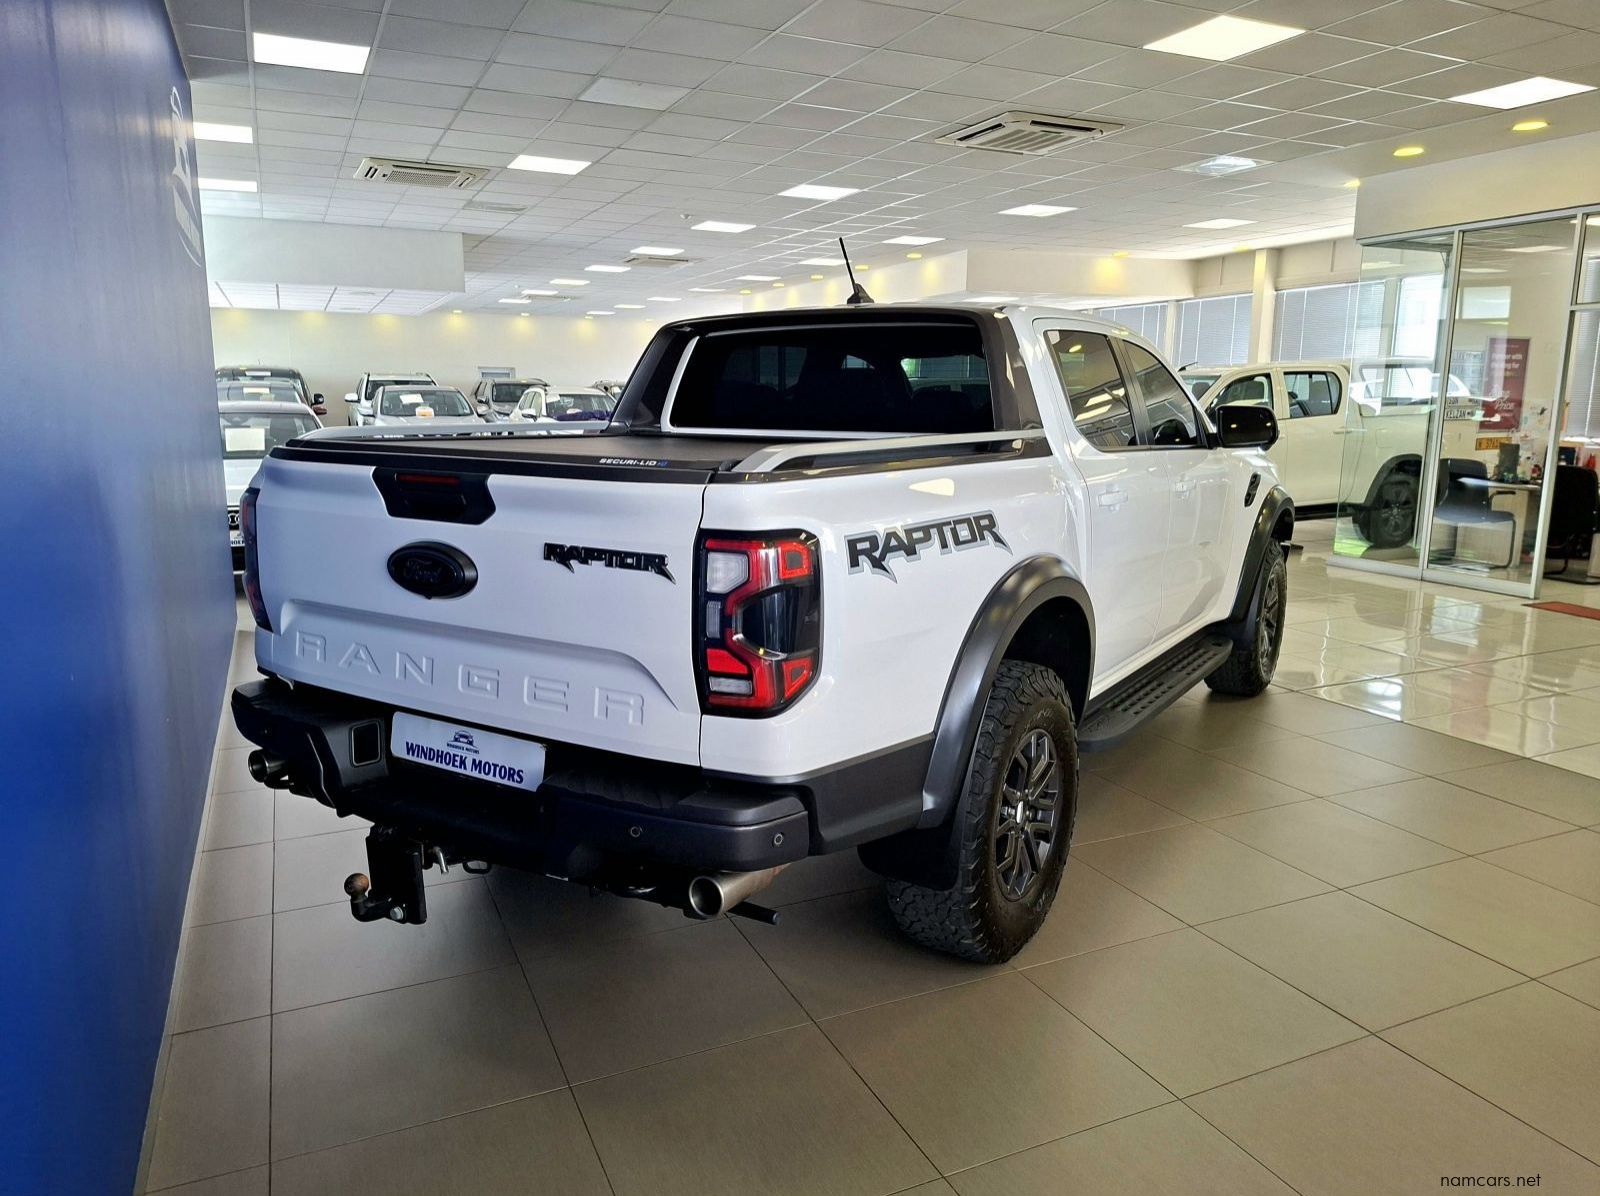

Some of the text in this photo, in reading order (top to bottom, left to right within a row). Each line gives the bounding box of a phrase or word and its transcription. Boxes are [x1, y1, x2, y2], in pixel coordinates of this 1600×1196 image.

[599, 457, 658, 467] SECURI-LID
[543, 542, 677, 585] RAPTOR
[844, 509, 1014, 585] RAPTOR
[295, 629, 646, 727] RANGER
[405, 741, 524, 784] WINDHOEK MOTORS
